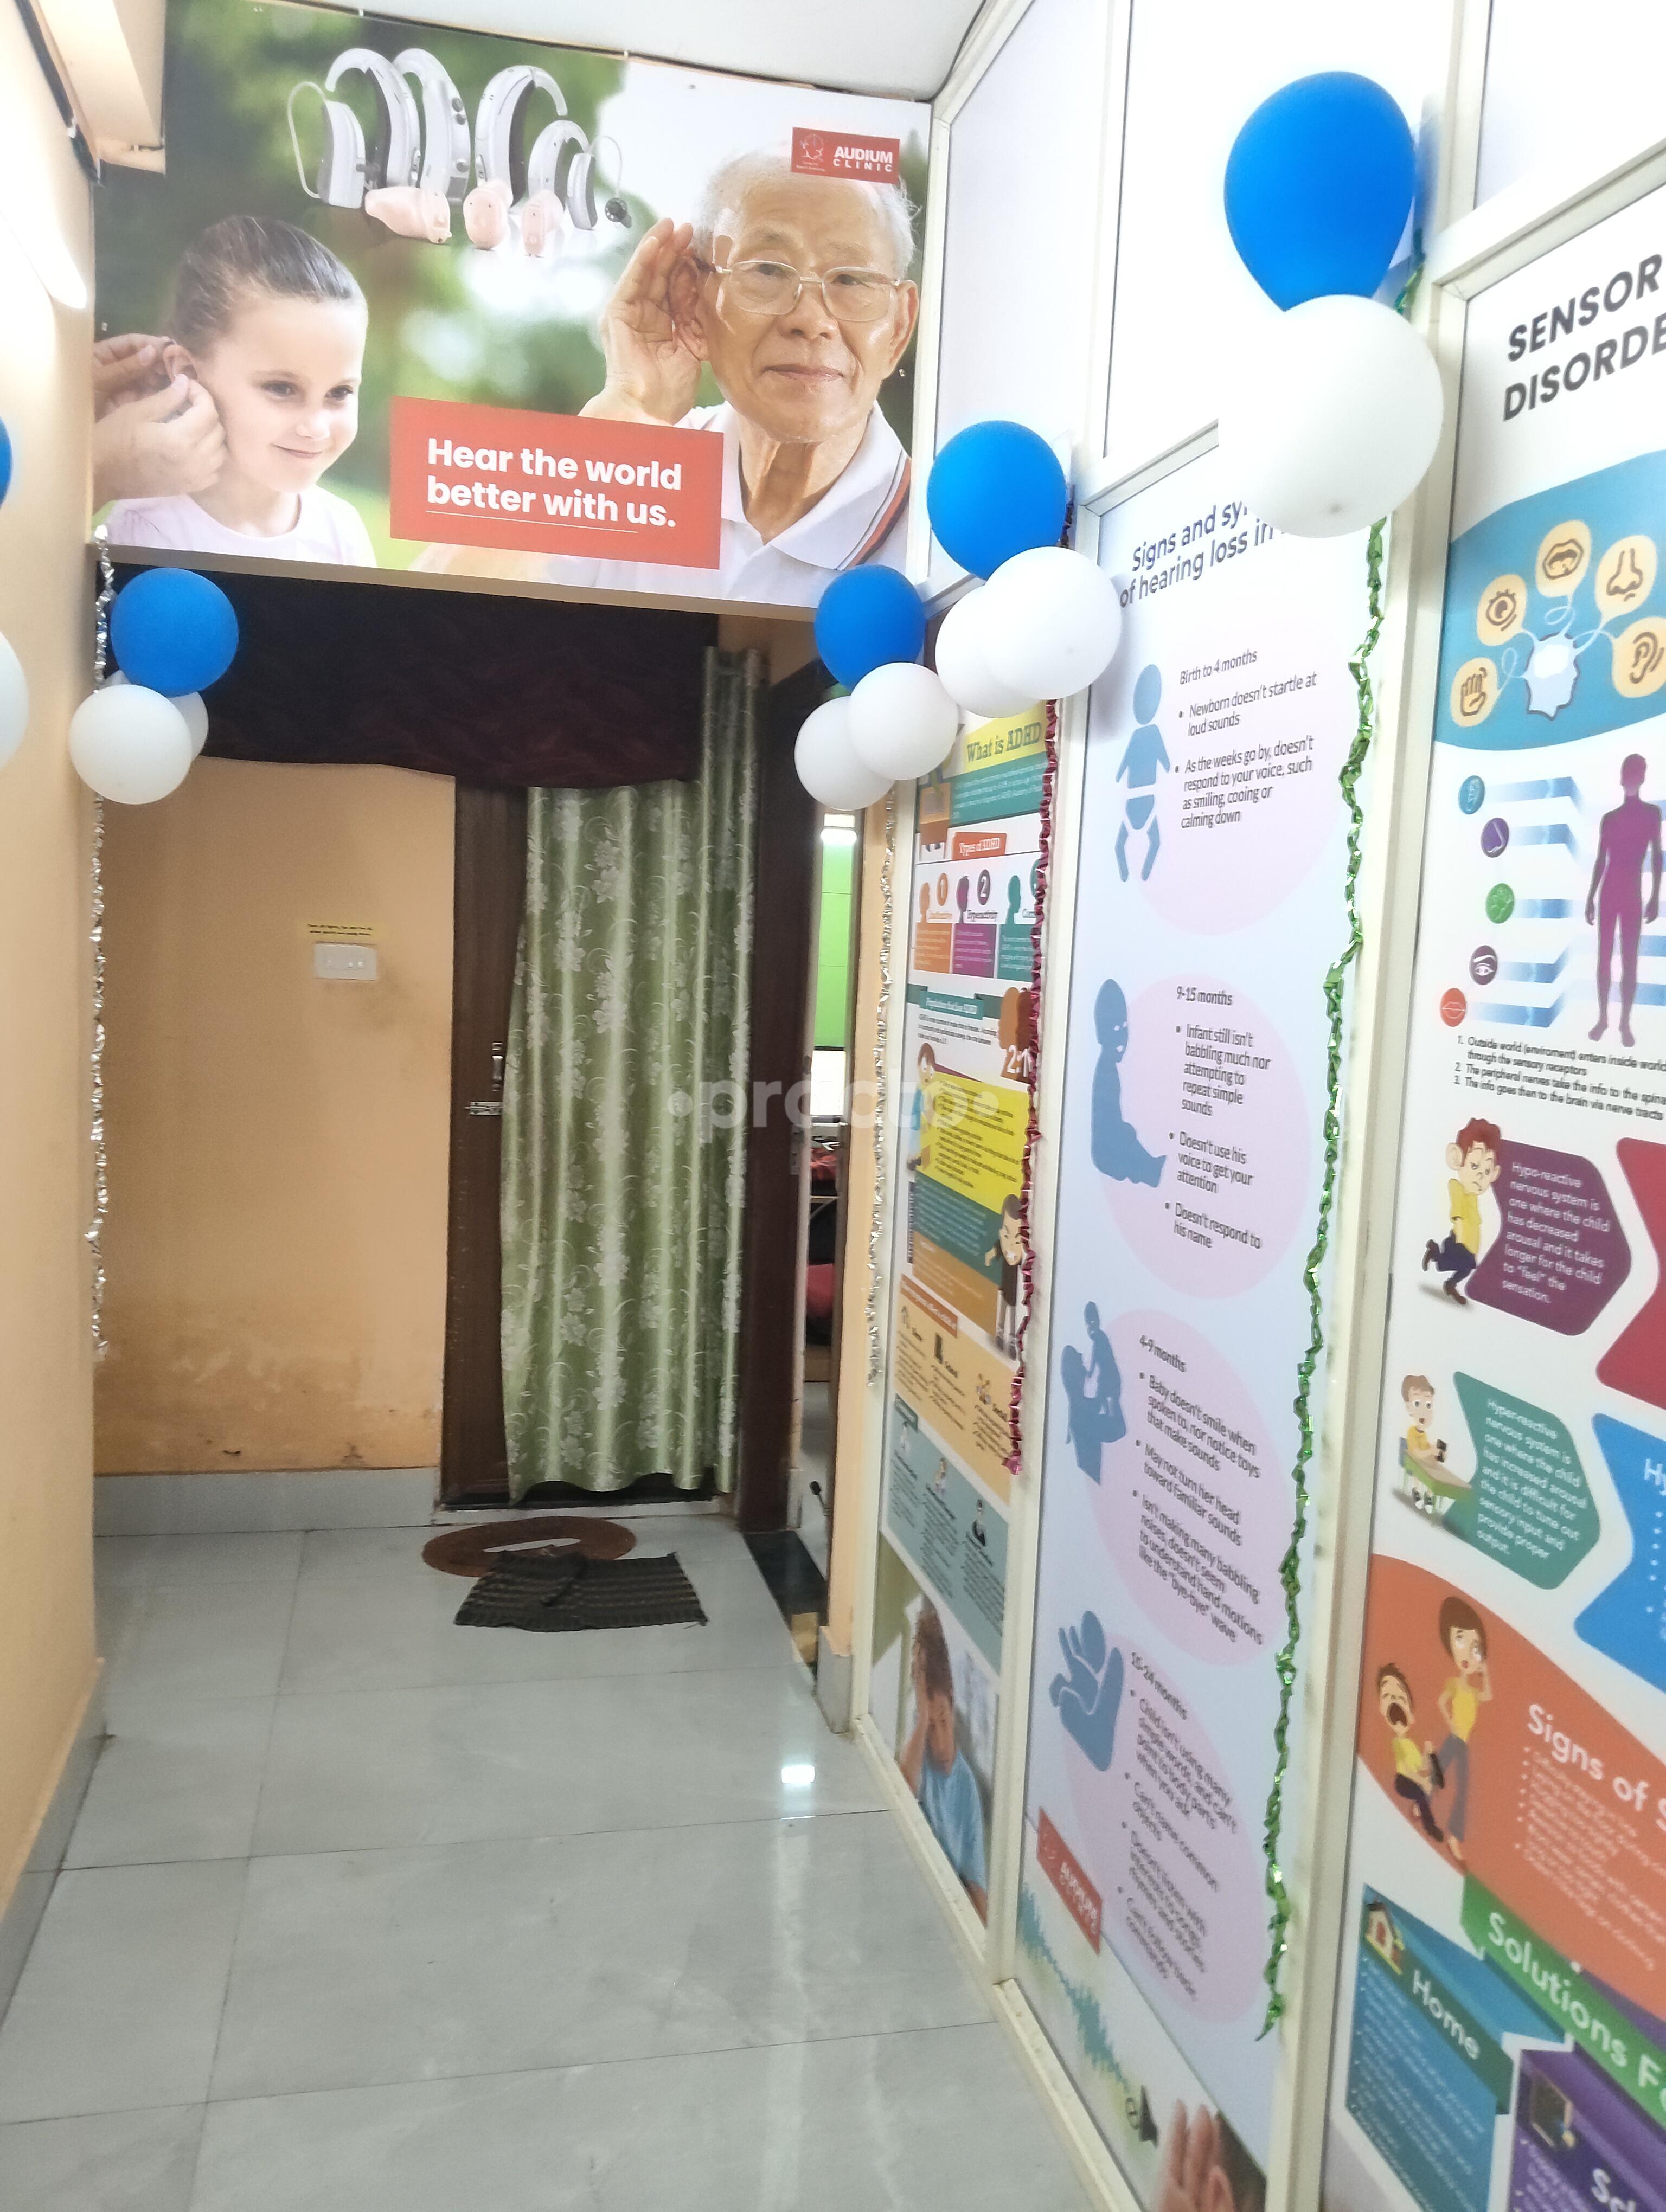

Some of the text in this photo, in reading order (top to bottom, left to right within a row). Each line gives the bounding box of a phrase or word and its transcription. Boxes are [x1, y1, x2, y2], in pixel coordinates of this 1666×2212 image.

[833, 158, 892, 172] CLINIC
[834, 146, 893, 163] AUDIUM
[428, 438, 682, 490] Hear the world
[427, 475, 676, 528] better with us.
[1132, 533, 1176, 571] Signs
[1181, 505, 1216, 547] and
[1119, 578, 1136, 608] of
[1139, 552, 1204, 600] hearing
[1210, 531, 1247, 567] loss
[1180, 648, 1257, 684] Birth to 4 months
[1189, 672, 1317, 718] Newborn doesn't startle at
[1188, 711, 1241, 736] loud sounds
[967, 722, 1042, 762] What is ADHD
[1185, 735, 1313, 774] As the weeks go by, doesn't
[1183, 756, 1312, 793] respond to your voice, such
[1182, 787, 1273, 809] as smiling, cooing or
[1181, 807, 1241, 828] calming down
[959, 838, 999, 856] Types of ADHD
[981, 876, 987, 897] 2
[1176, 986, 1233, 1006] 9-15 months
[1187, 1024, 1253, 1047] Infant still isn't
[1185, 1041, 1271, 1070] babbling much nor
[1468, 1036, 1497, 1050] Outside
[1500, 1040, 1522, 1052] world
[1578, 1051, 1606, 1063] enters
[1607, 1054, 1637, 1068] inside
[1468, 1050, 1587, 1076] through the sensory receptors
[1184, 1062, 1245, 1086] attempting to
[1466, 1063, 1479, 1075] The
[1481, 1066, 1521, 1082] peripheral
[1522, 1075, 1550, 1086] nerves
[1552, 1077, 1570, 1089] take
[1573, 1079, 1586, 1092] the
[1590, 1082, 1607, 1096] info
[1610, 1086, 1619, 1097] to
[1623, 1088, 1638, 1101] the
[1181, 1098, 1213, 1116] sounds
[1182, 1081, 1243, 1105] repeat simple
[1465, 1077, 1478, 1088] The
[1479, 1078, 1495, 1091] info
[1497, 1083, 1516, 1096] goes
[1518, 1086, 1536, 1098] then
[1539, 1090, 1547, 1101] to
[1550, 1092, 1564, 1103] the
[1566, 1093, 1588, 1108] brain
[1591, 1099, 1603, 1110] via
[1606, 1103, 1632, 1115] nerve
[1636, 1105, 1663, 1120] tracts
[1180, 1131, 1247, 1164] Doesn't use his
[1177, 1169, 1218, 1193] attention
[1178, 1153, 1254, 1185] voice to get your
[1512, 1161, 1582, 1188] Hypo-reactive
[1510, 1181, 1600, 1211] nervous system is
[1175, 1203, 1261, 1249] Doesn't respond to
[1508, 1211, 1579, 1242] has decreased
[1509, 1198, 1611, 1232] one where the child
[1174, 1220, 1213, 1248] his name
[1506, 1231, 1605, 1268] arousal and it takes
[1503, 1262, 1515, 1273] to
[1548, 1276, 1567, 1290] the
[1504, 1244, 1602, 1284] longer for the child
[1154, 1345, 1186, 1372] months
[1149, 1375, 1169, 1399] Baby
[1202, 1413, 1226, 1437] smile
[1228, 1429, 1257, 1455] when
[1148, 1396, 1176, 1422] spoken
[1207, 1433, 1236, 1463] notice
[1238, 1454, 1261, 1478] toys
[1148, 1410, 1220, 1471] that make sounds
[1528, 1703, 1649, 1811] Signs of
[1488, 1912, 1626, 2067] Solutions
[1413, 1970, 1480, 2060] Home
